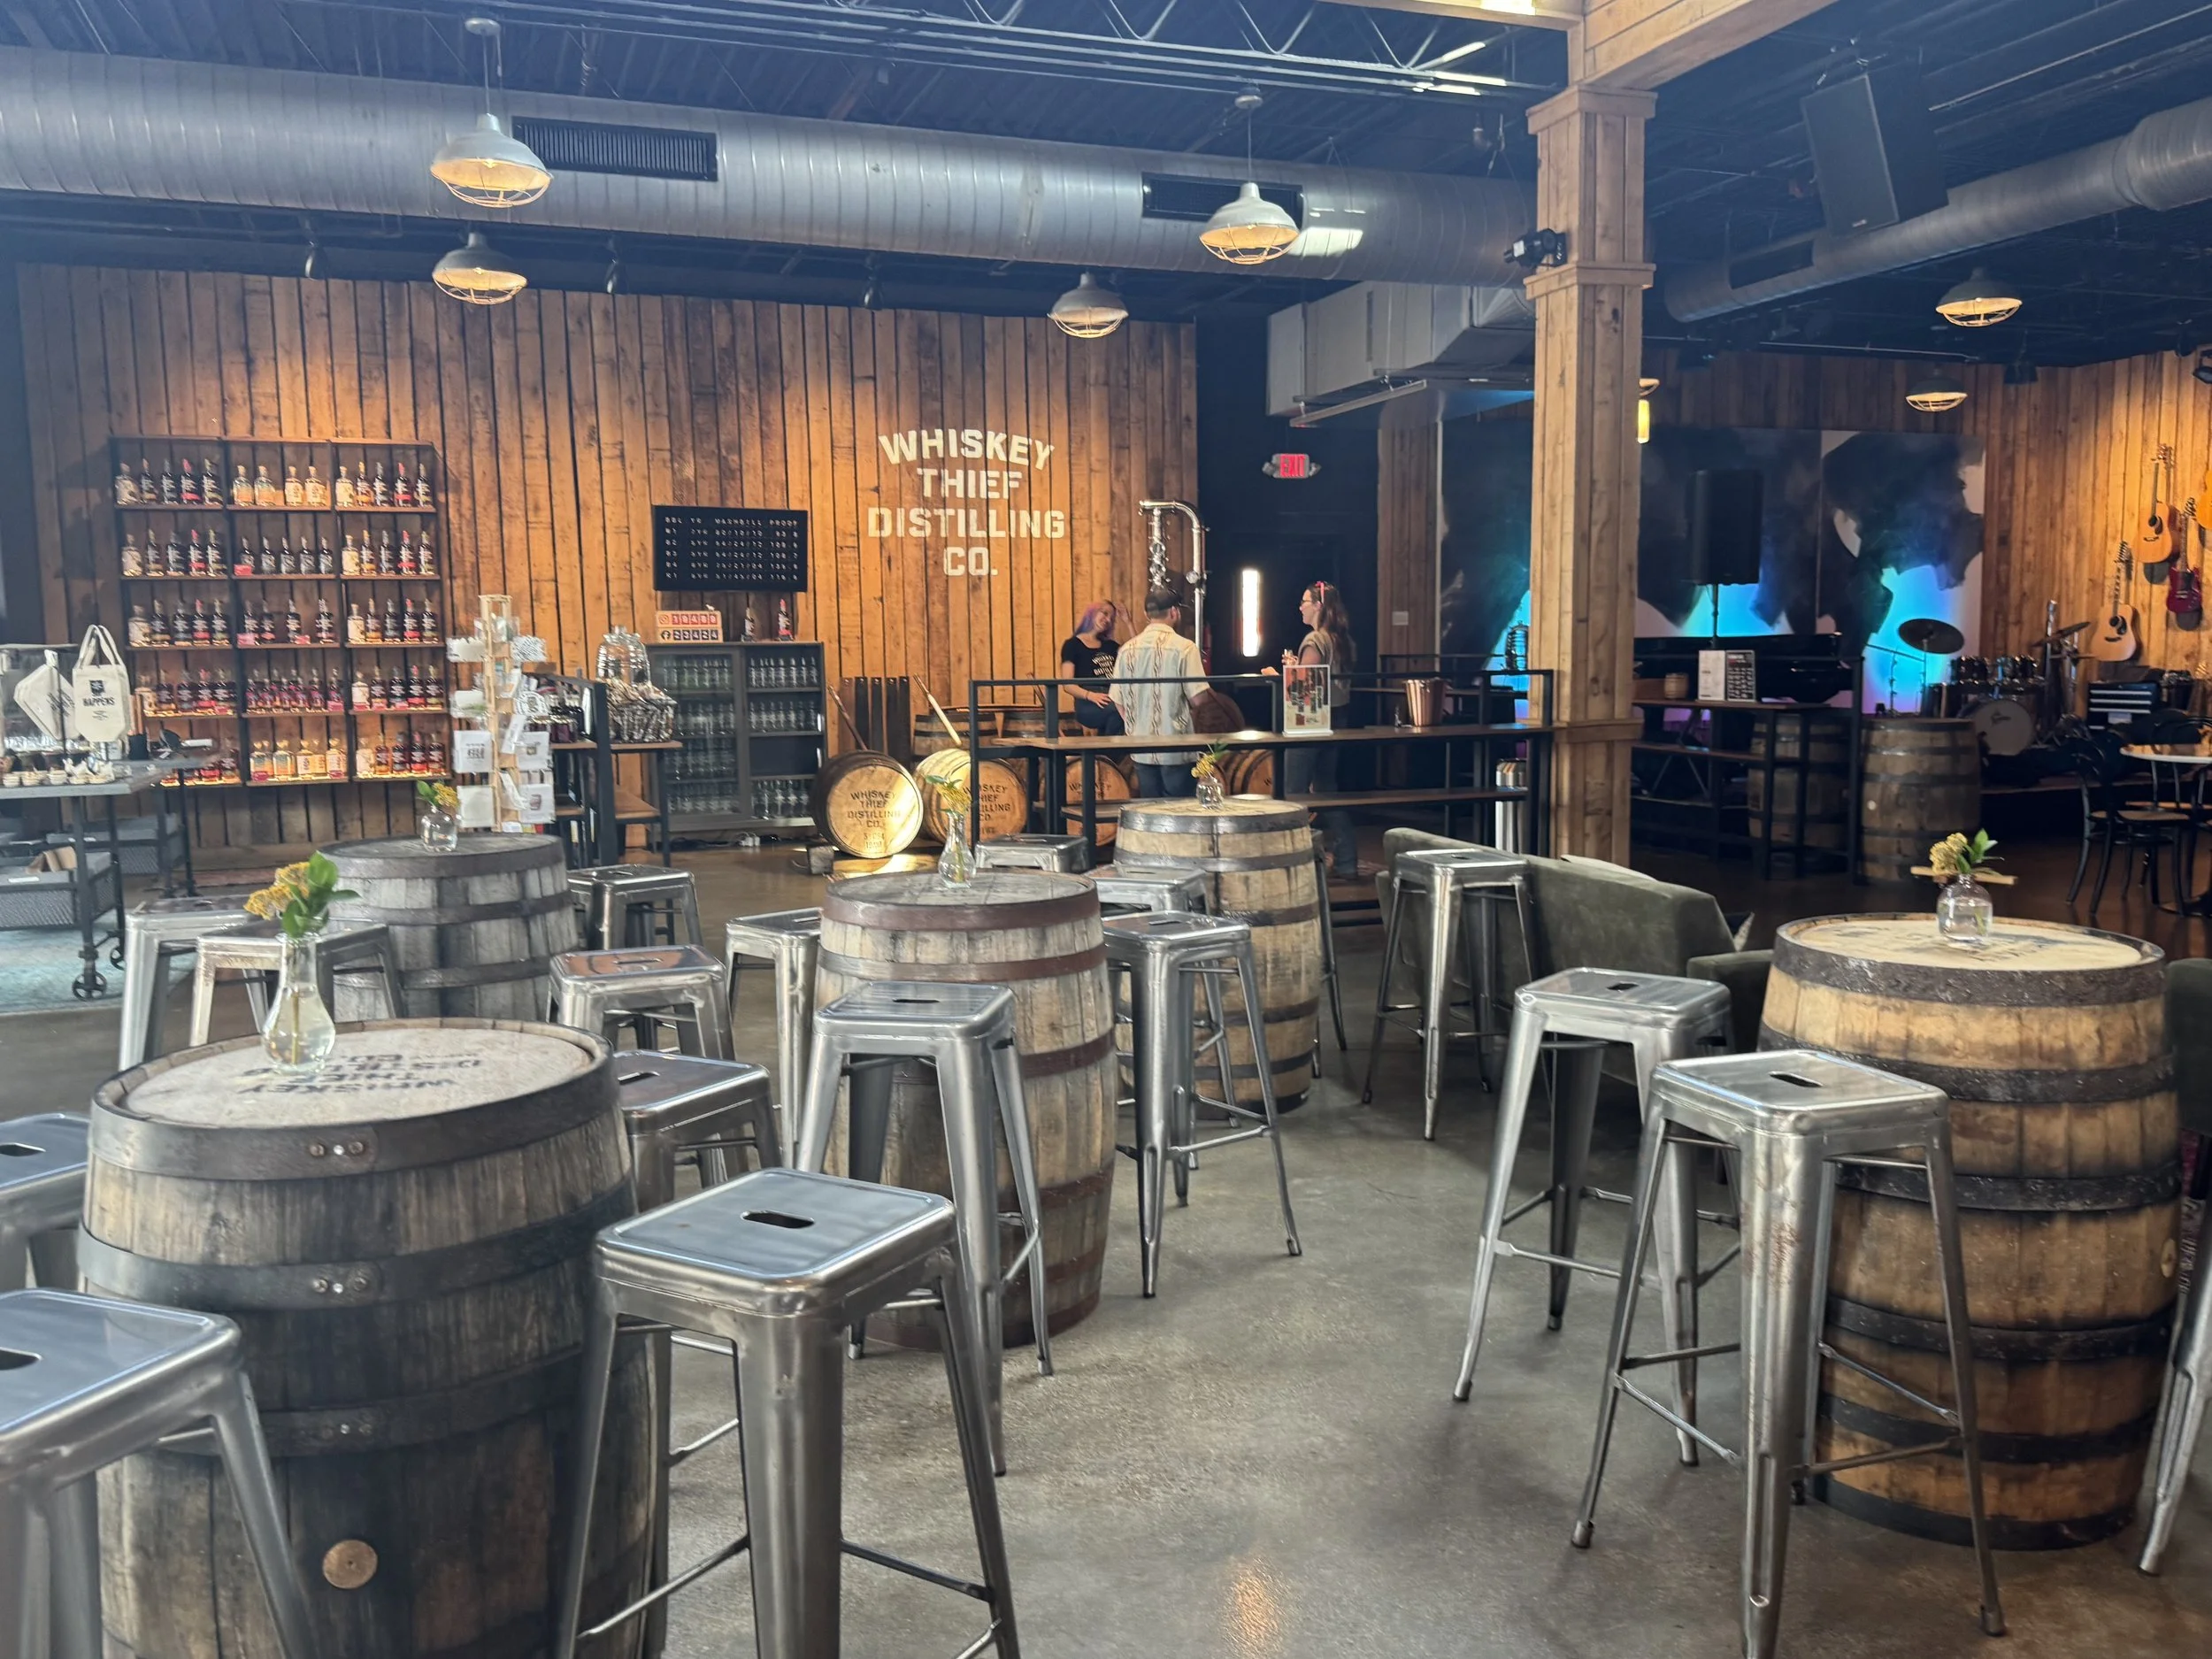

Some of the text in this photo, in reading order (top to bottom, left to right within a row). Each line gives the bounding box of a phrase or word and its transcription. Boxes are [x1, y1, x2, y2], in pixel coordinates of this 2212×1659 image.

[879, 428, 1055, 471] WHISKEY
[1280, 455, 1305, 478] EXIT
[917, 468, 1023, 499] THIEF
[868, 507, 1065, 539] DISTILLING
[943, 547, 999, 576] CO.
[674, 631, 718, 640] 23424
[83, 697, 116, 707] HAPPENS
